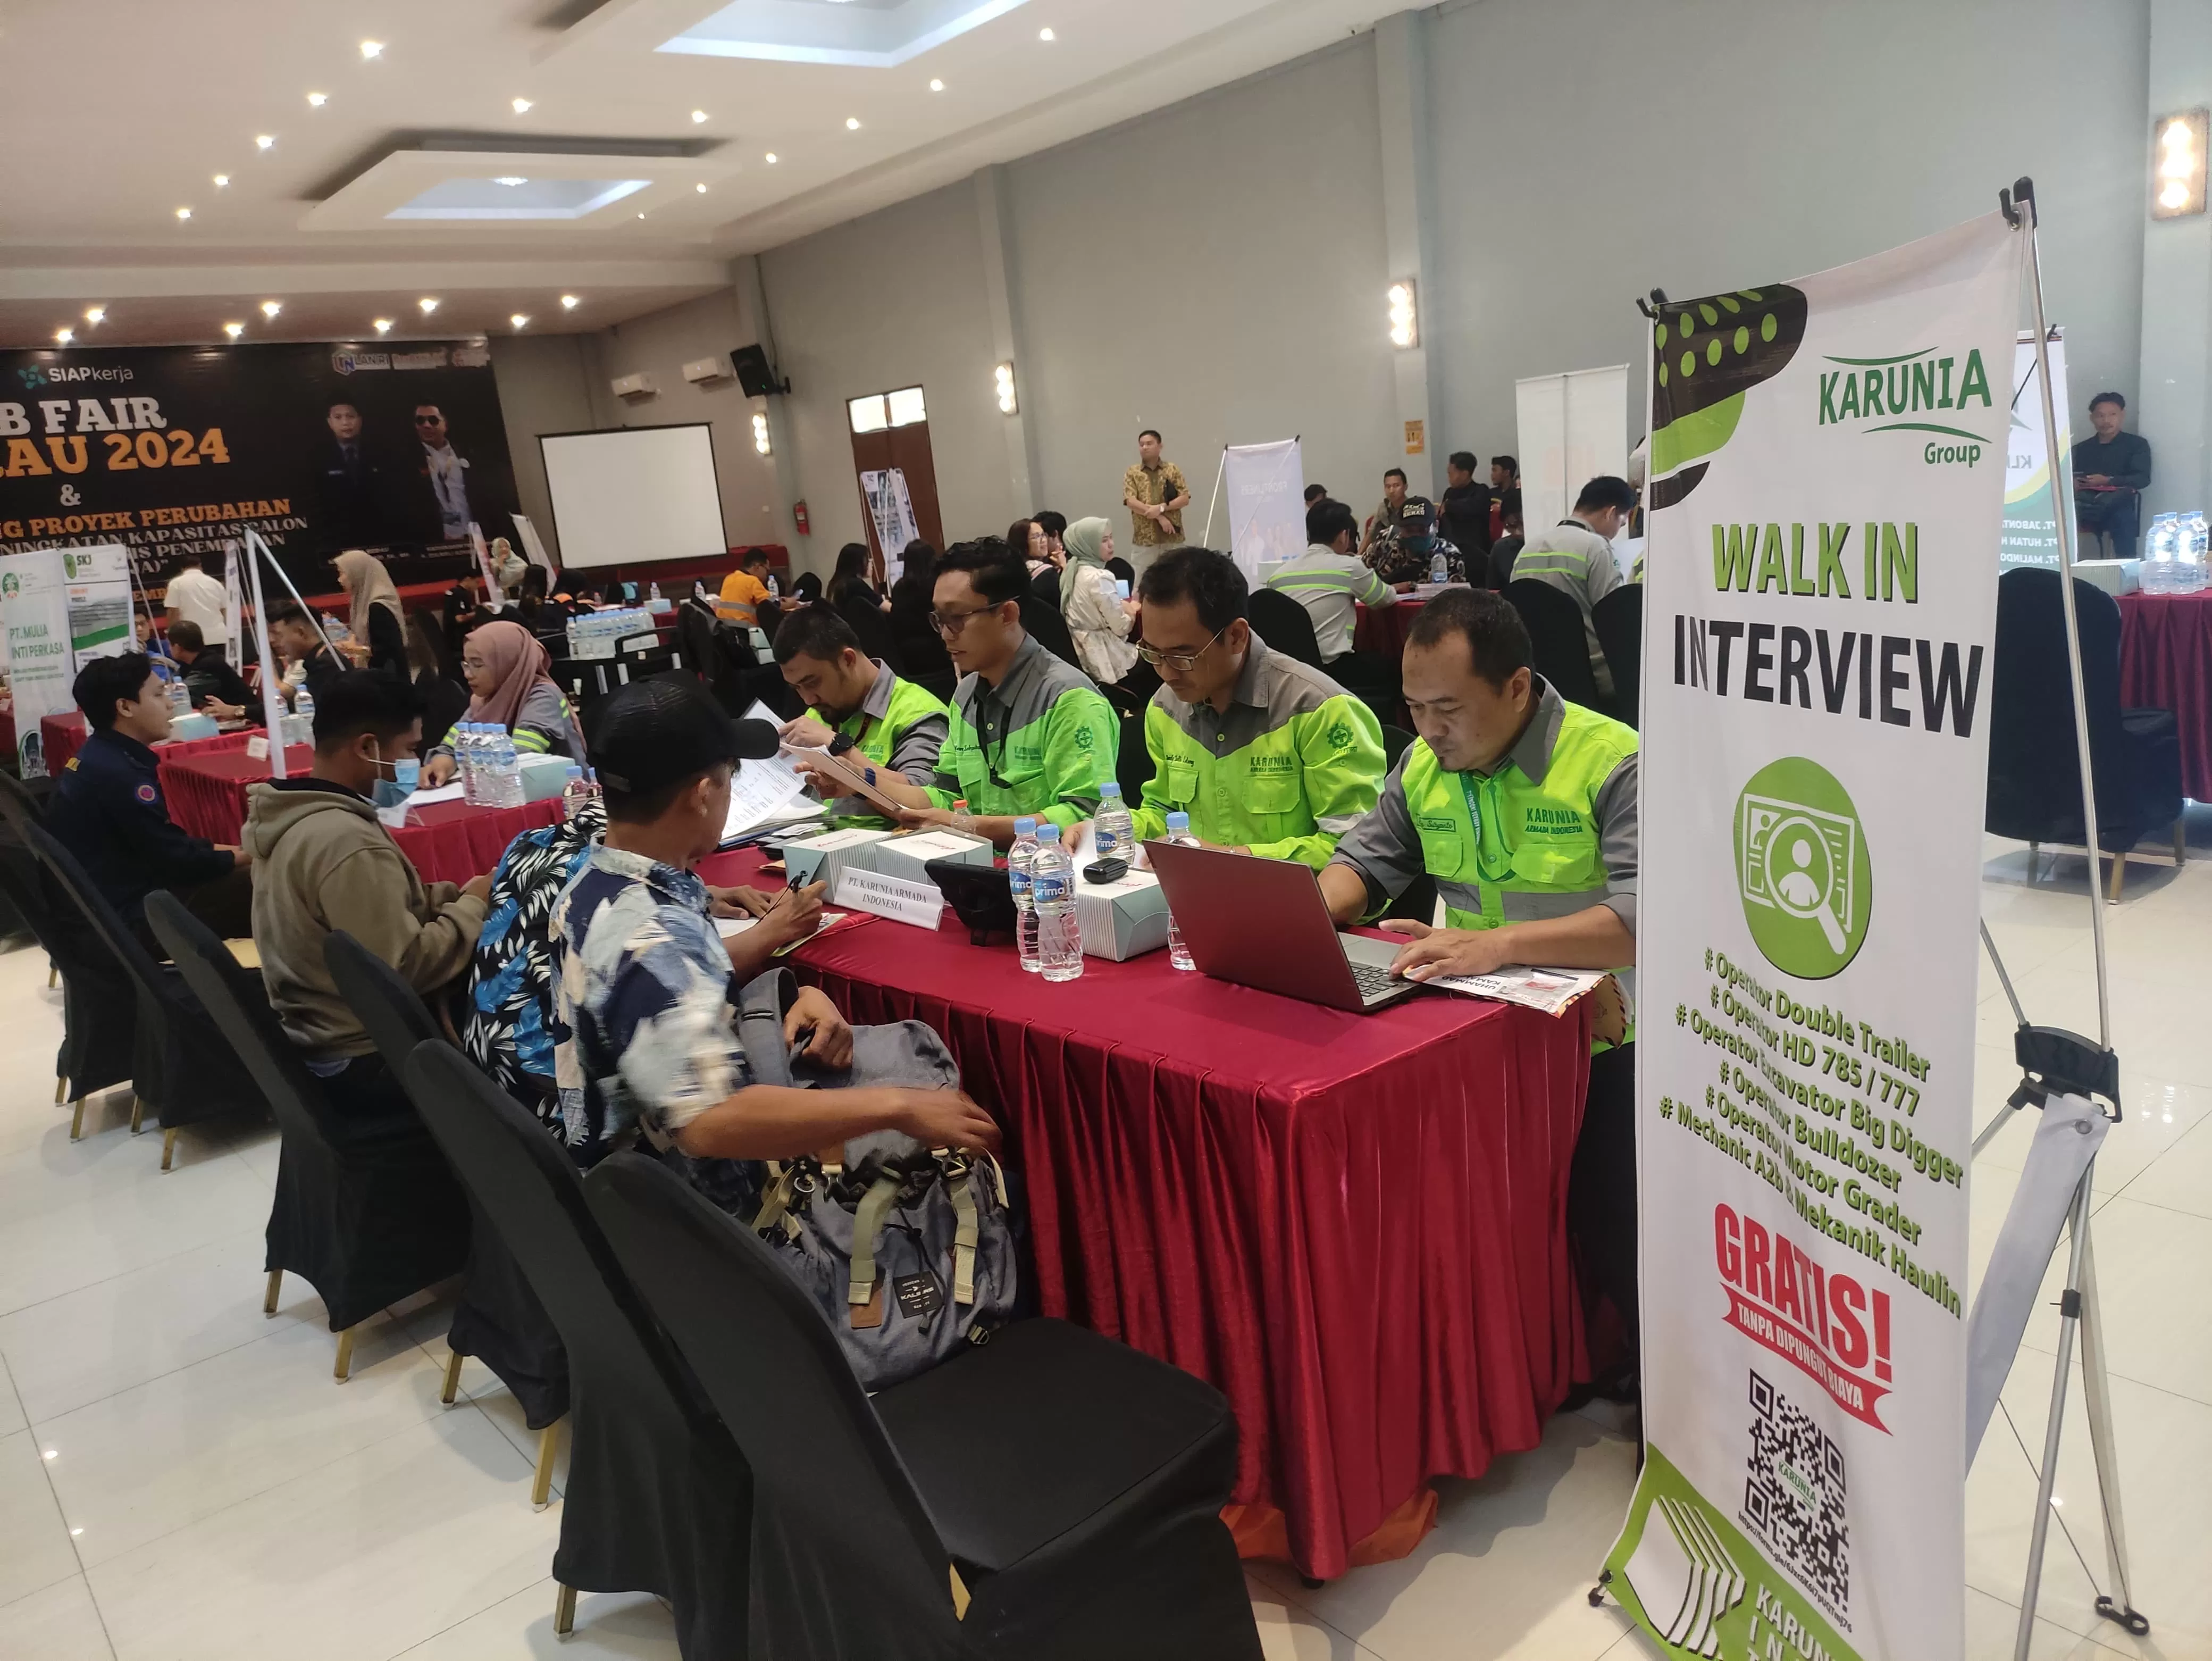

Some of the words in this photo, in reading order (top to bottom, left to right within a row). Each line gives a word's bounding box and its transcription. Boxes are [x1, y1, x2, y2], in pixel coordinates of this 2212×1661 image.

[49, 365, 134, 383] SIAPkerja
[1819, 349, 1992, 424] KARUNIA
[39, 397, 167, 434] FAIR
[0, 435, 88, 478] AU
[103, 428, 230, 470] 2024
[1924, 442, 1981, 468] Group
[60, 484, 81, 506] &
[0, 520, 24, 539] G
[29, 511, 136, 536] PROYEK
[139, 498, 291, 527] PERUBAHAN
[129, 522, 239, 545] KAPASITAS
[77, 555, 92, 565] SKJ
[128, 546, 152, 559] IS
[1712, 522, 1851, 599] WALK
[1864, 522, 1918, 604] IN
[10, 628, 23, 640] PT.
[23, 624, 48, 638] MULIA
[12, 646, 27, 660] INTI
[30, 642, 64, 657] PERKASA
[1674, 614, 1984, 738] INTERVIEW
[1251, 756, 1292, 766] KARUNIA
[1524, 825, 1549, 833] ARMADA
[1551, 825, 1583, 834] INDONESIA
[1527, 808, 1581, 824] KARUNIA
[848, 877, 858, 887] PT.
[860, 879, 893, 896] KARUNIA
[894, 888, 927, 903] ARMADA
[862, 894, 902, 911] INDONESIA
[1442, 976, 1496, 990] UHAMMAD
[1704, 947, 1714, 972] #
[1716, 952, 1772, 1012] Operator
[1776, 989, 1855, 1046] Double
[1859, 1021, 1930, 1083] Trailer
[1711, 983, 1719, 1009] #
[1722, 990, 1779, 1051] Operator
[1783, 1030, 1815, 1067] HD
[1822, 1045, 1862, 1088] 785
[1866, 1066, 1875, 1096] /
[1880, 1072, 1920, 1116] 777
[1675, 1002, 1687, 1026] #
[1690, 1008, 1758, 1067] Operator
[1759, 1047, 1846, 1120] Excavator
[1850, 1099, 1885, 1149] Big
[1890, 1126, 1964, 1190] Digger
[1720, 1059, 1729, 1085] #
[1733, 1067, 1790, 1133] Operator
[1795, 1114, 1901, 1193] Bulldozer
[1706, 1084, 1715, 1108] #
[1717, 1091, 1782, 1157] Operator
[1783, 1139, 1839, 1197] Motor
[1844, 1178, 1922, 1247] Grader
[1659, 1096, 1672, 1120] #
[1678, 1101, 1752, 1168] Mechanic
[1755, 1151, 1784, 1193] A2b
[1795, 1192, 1886, 1267] Mekanik
[1891, 1243, 1961, 1321] Haulin
[1714, 1203, 1893, 1383] GRATIS!
[1737, 1302, 1775, 1341] TANPA
[1777, 1329, 1826, 1382] DIPUNGUT
[1828, 1371, 1864, 1411] BIAYA
[1778, 1462, 1817, 1505] KARUNIA
